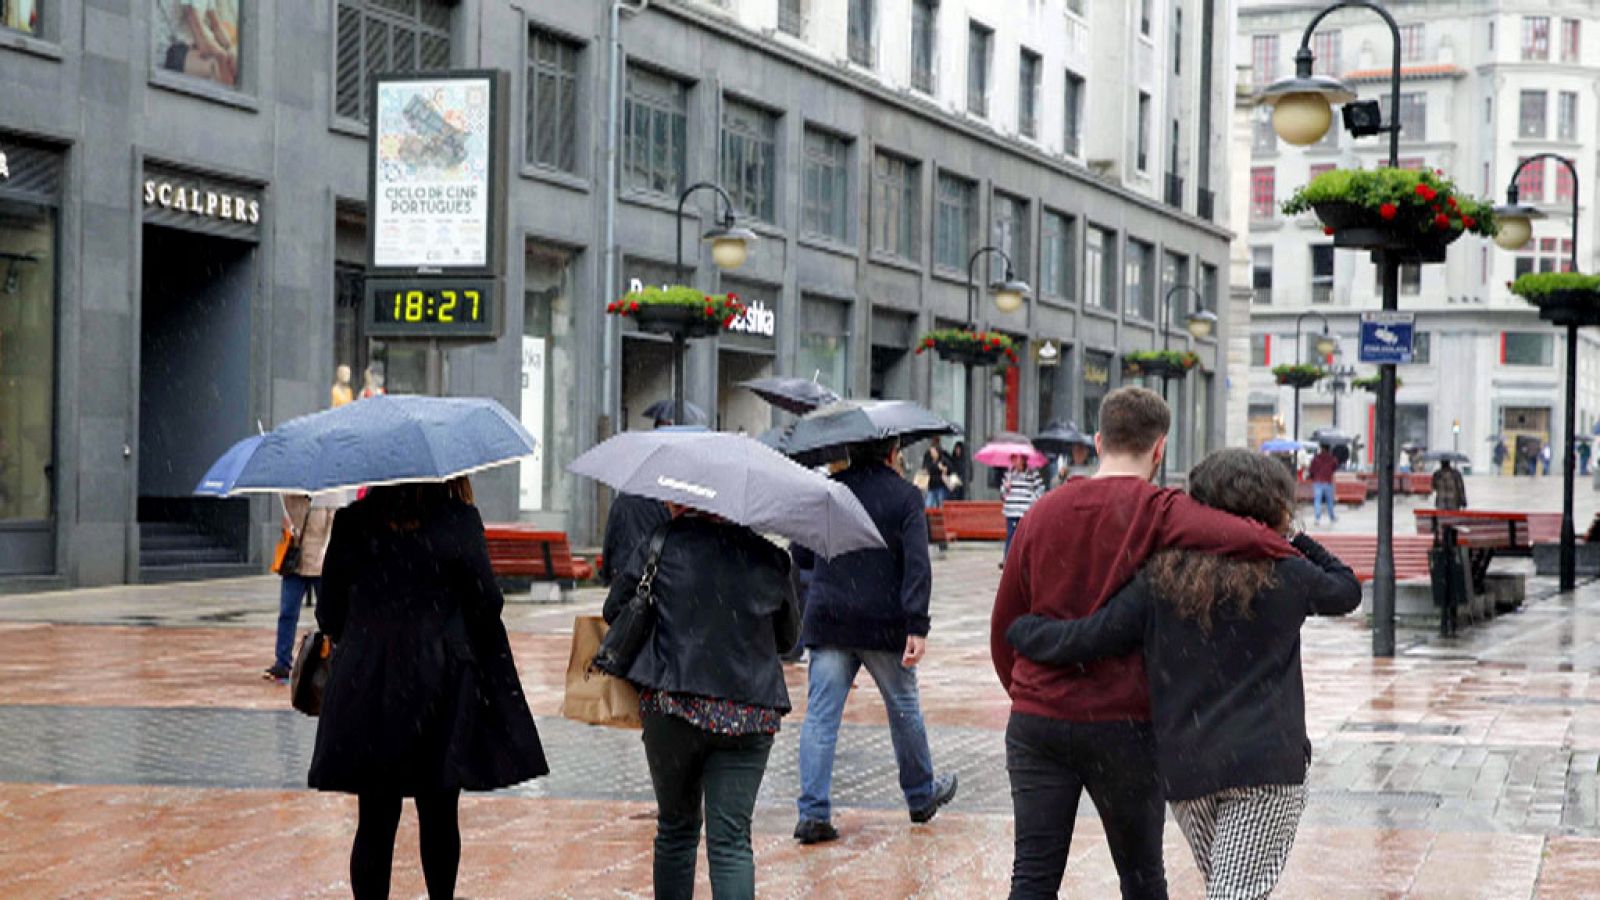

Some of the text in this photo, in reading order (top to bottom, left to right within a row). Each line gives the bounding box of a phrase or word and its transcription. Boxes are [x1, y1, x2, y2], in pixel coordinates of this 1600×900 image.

[144, 180, 260, 223] SCALPERS
[385, 185, 478, 199] CICLO DE CINE
[394, 290, 480, 322] 18:27
